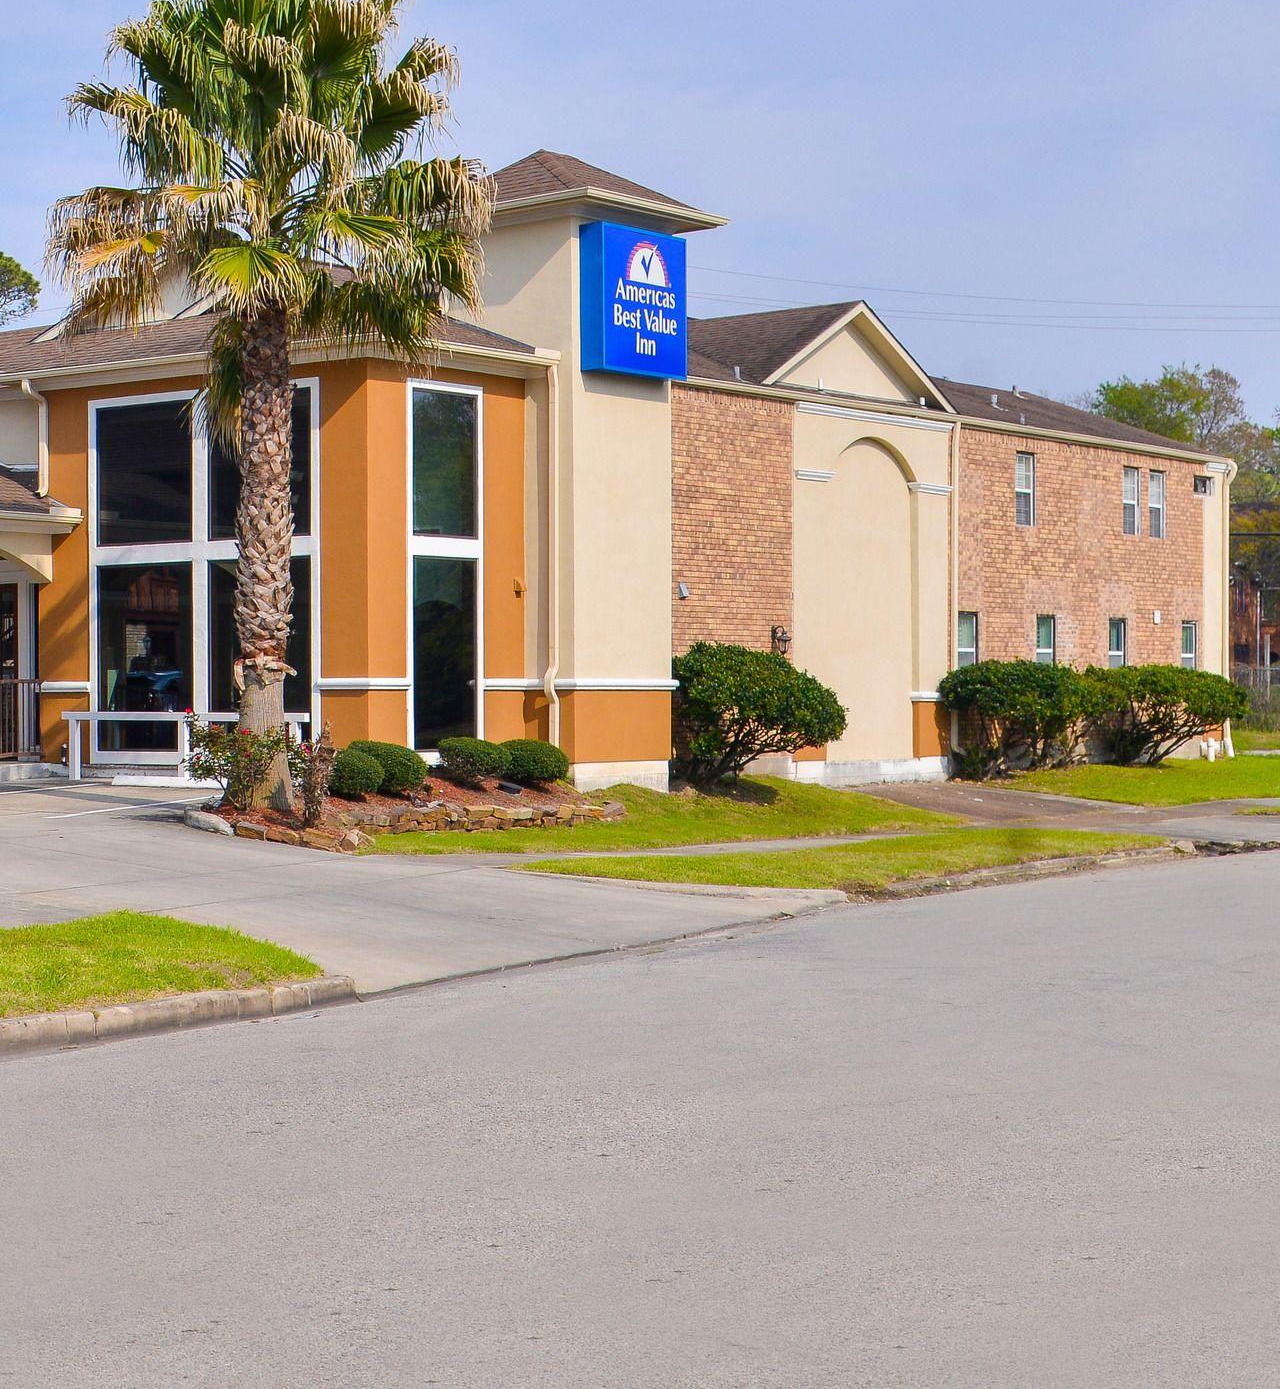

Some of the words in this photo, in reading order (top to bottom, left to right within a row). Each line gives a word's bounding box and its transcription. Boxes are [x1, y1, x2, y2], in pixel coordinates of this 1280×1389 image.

[615, 277, 676, 309] Americas
[613, 303, 642, 330] Best
[643, 308, 678, 336] Value
[635, 332, 656, 356] Inn
